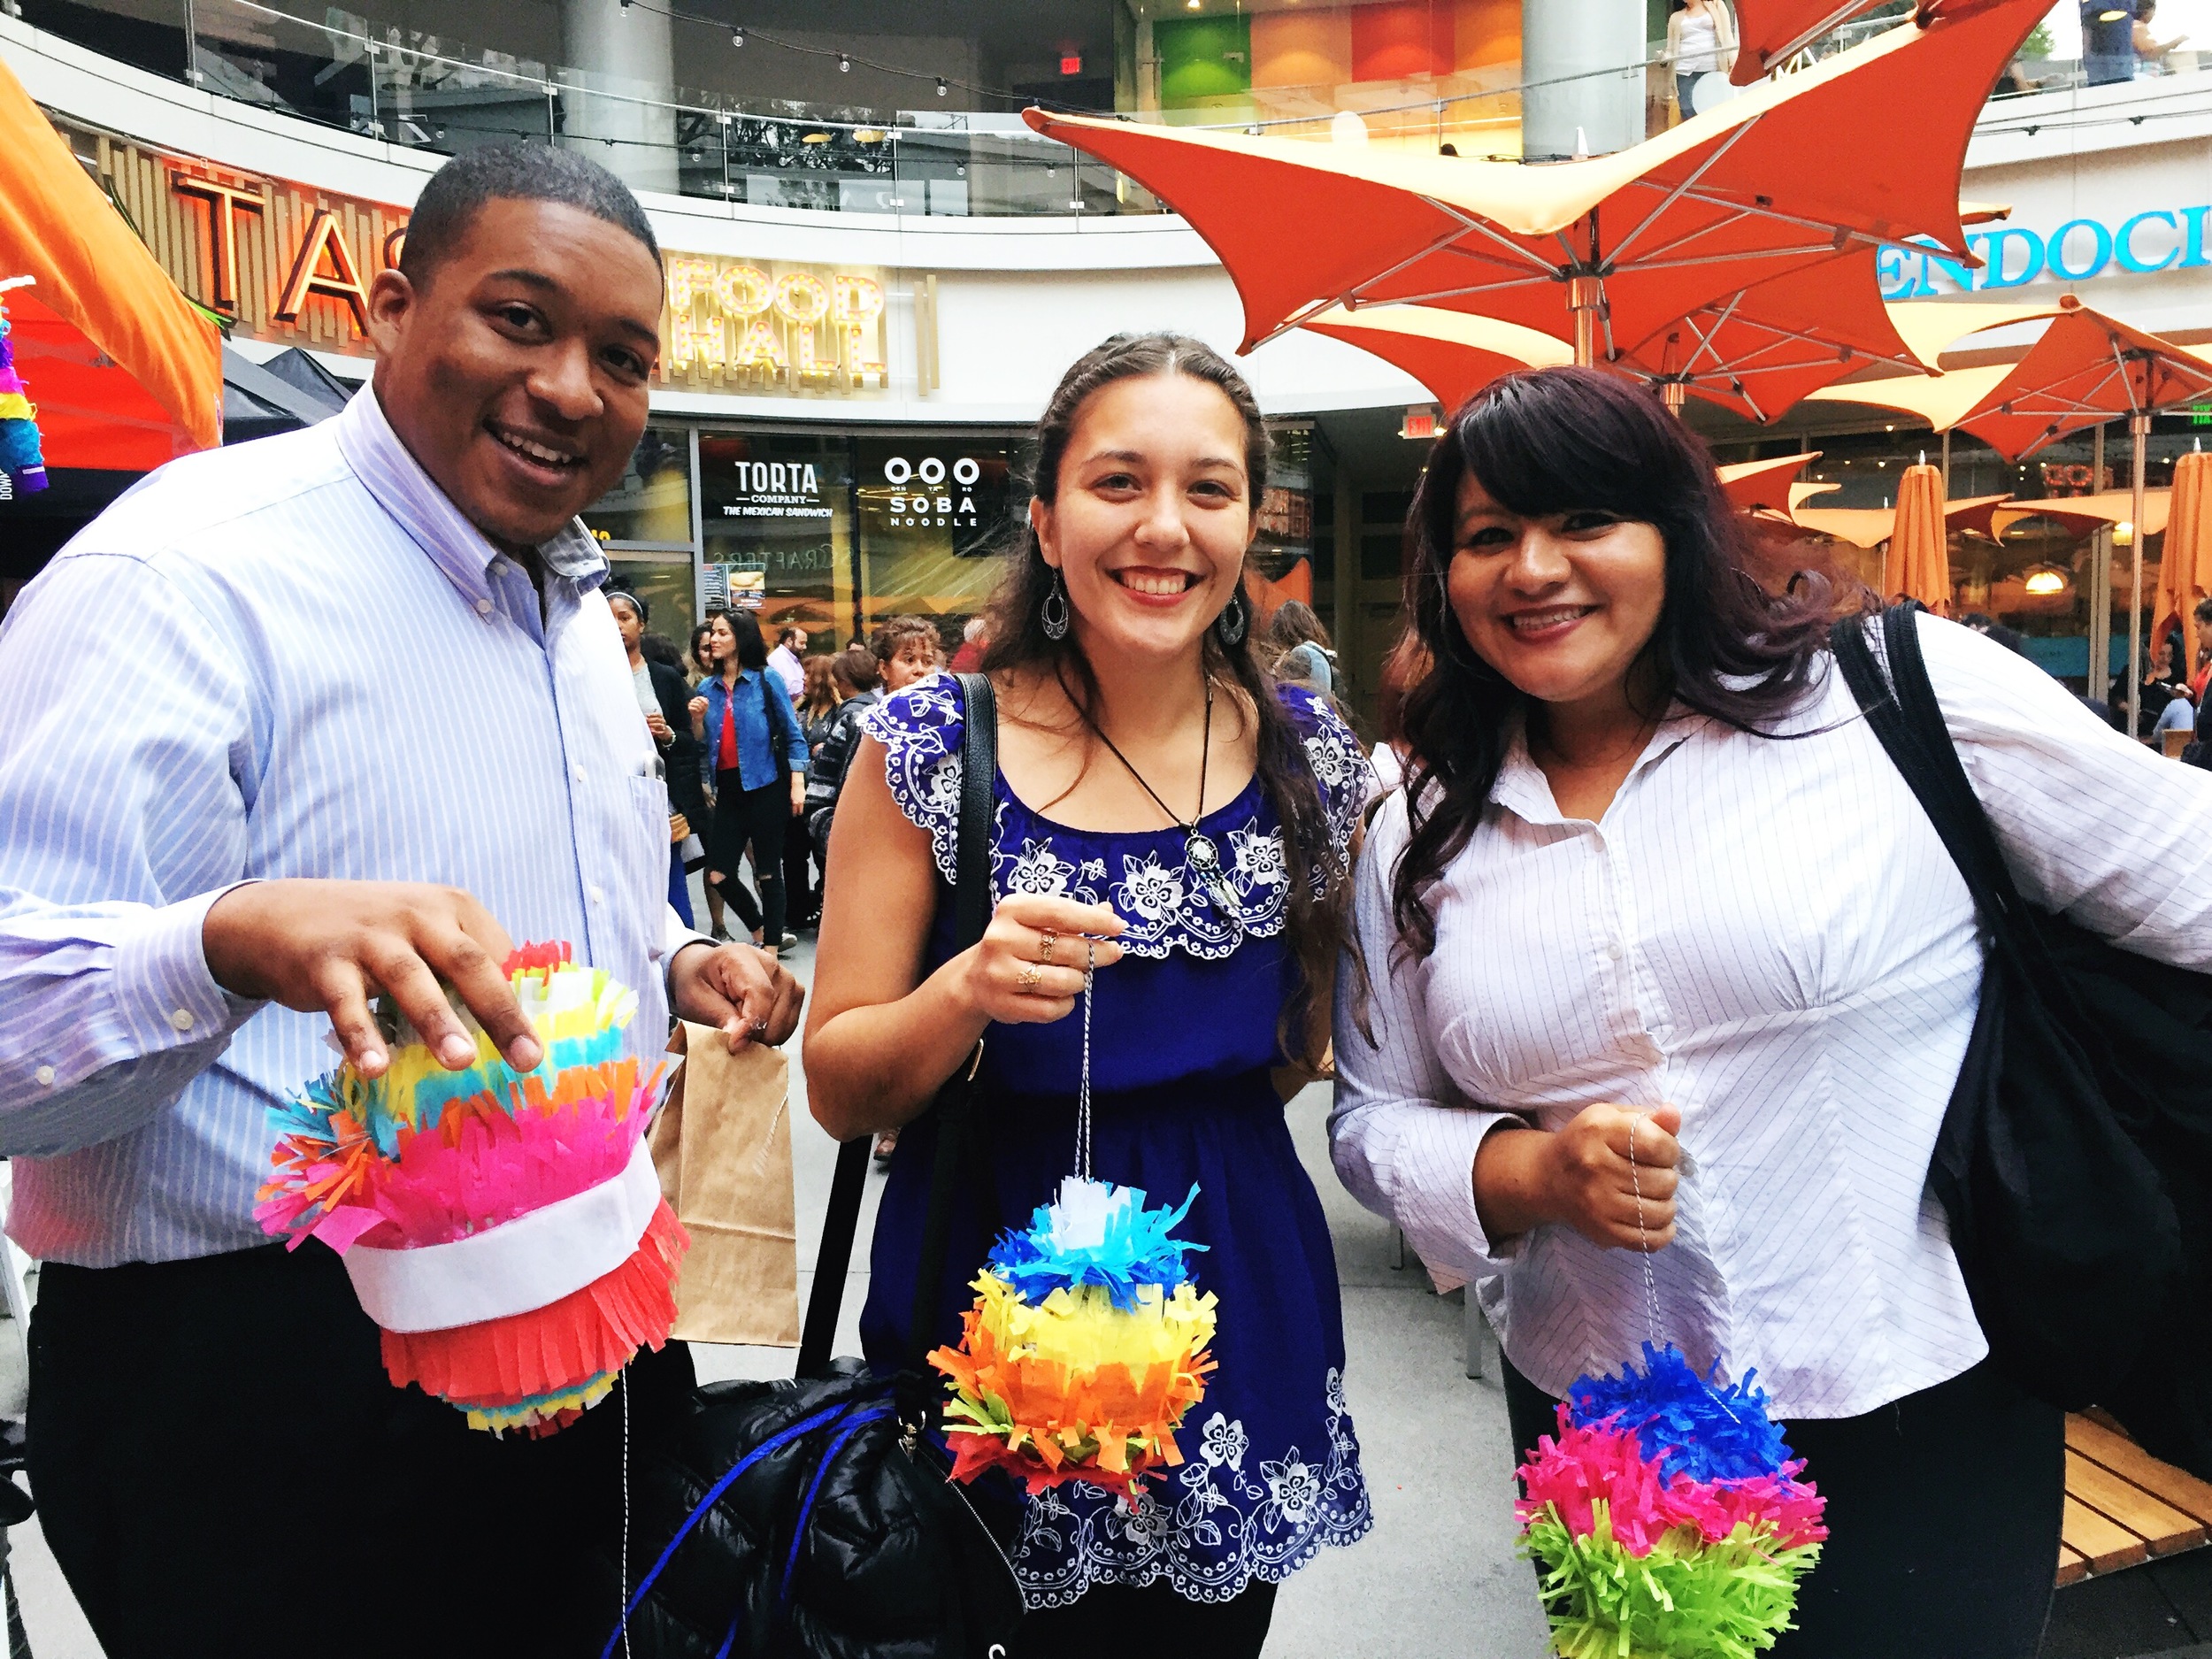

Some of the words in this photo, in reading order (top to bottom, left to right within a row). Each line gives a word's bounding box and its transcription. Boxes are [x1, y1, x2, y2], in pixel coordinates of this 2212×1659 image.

[171, 168, 408, 336] TA
[670, 257, 885, 322] FOOD
[674, 313, 887, 373] HALL
[734, 461, 818, 494] TORTA
[723, 506, 741, 516] THE
[742, 506, 785, 517] MEXICAN
[785, 508, 833, 518] SANDWICH
[750, 495, 807, 504] COMPANY
[889, 496, 977, 513] SOBA
[890, 518, 977, 526] NOODLE
